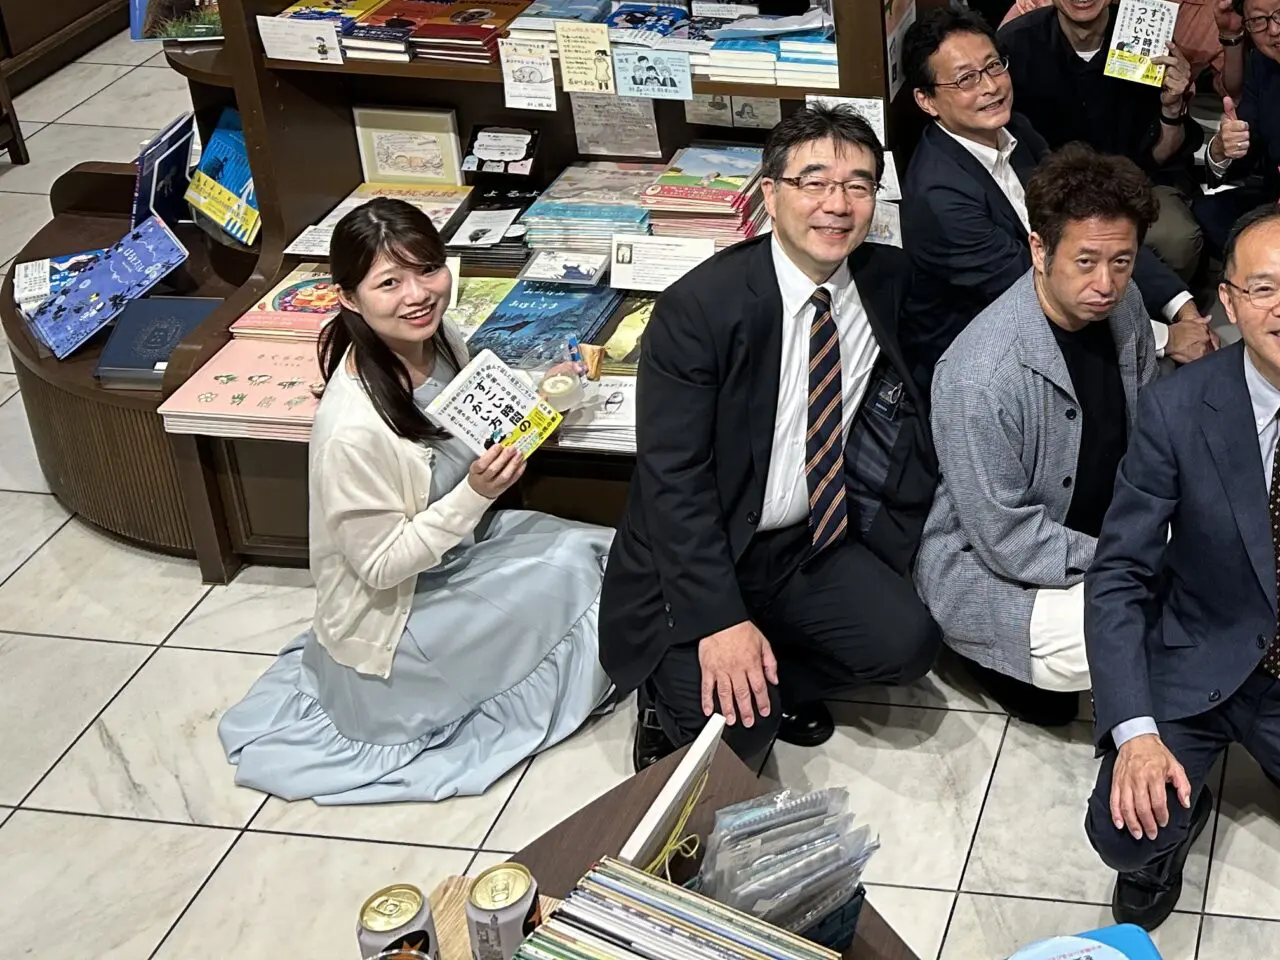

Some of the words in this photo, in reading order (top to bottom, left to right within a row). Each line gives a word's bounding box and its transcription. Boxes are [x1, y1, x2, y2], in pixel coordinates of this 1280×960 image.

[1131, 7, 1148, 45] つかい方
[1138, 8, 1160, 64] すごい時間の
[462, 393, 503, 431] つかい方
